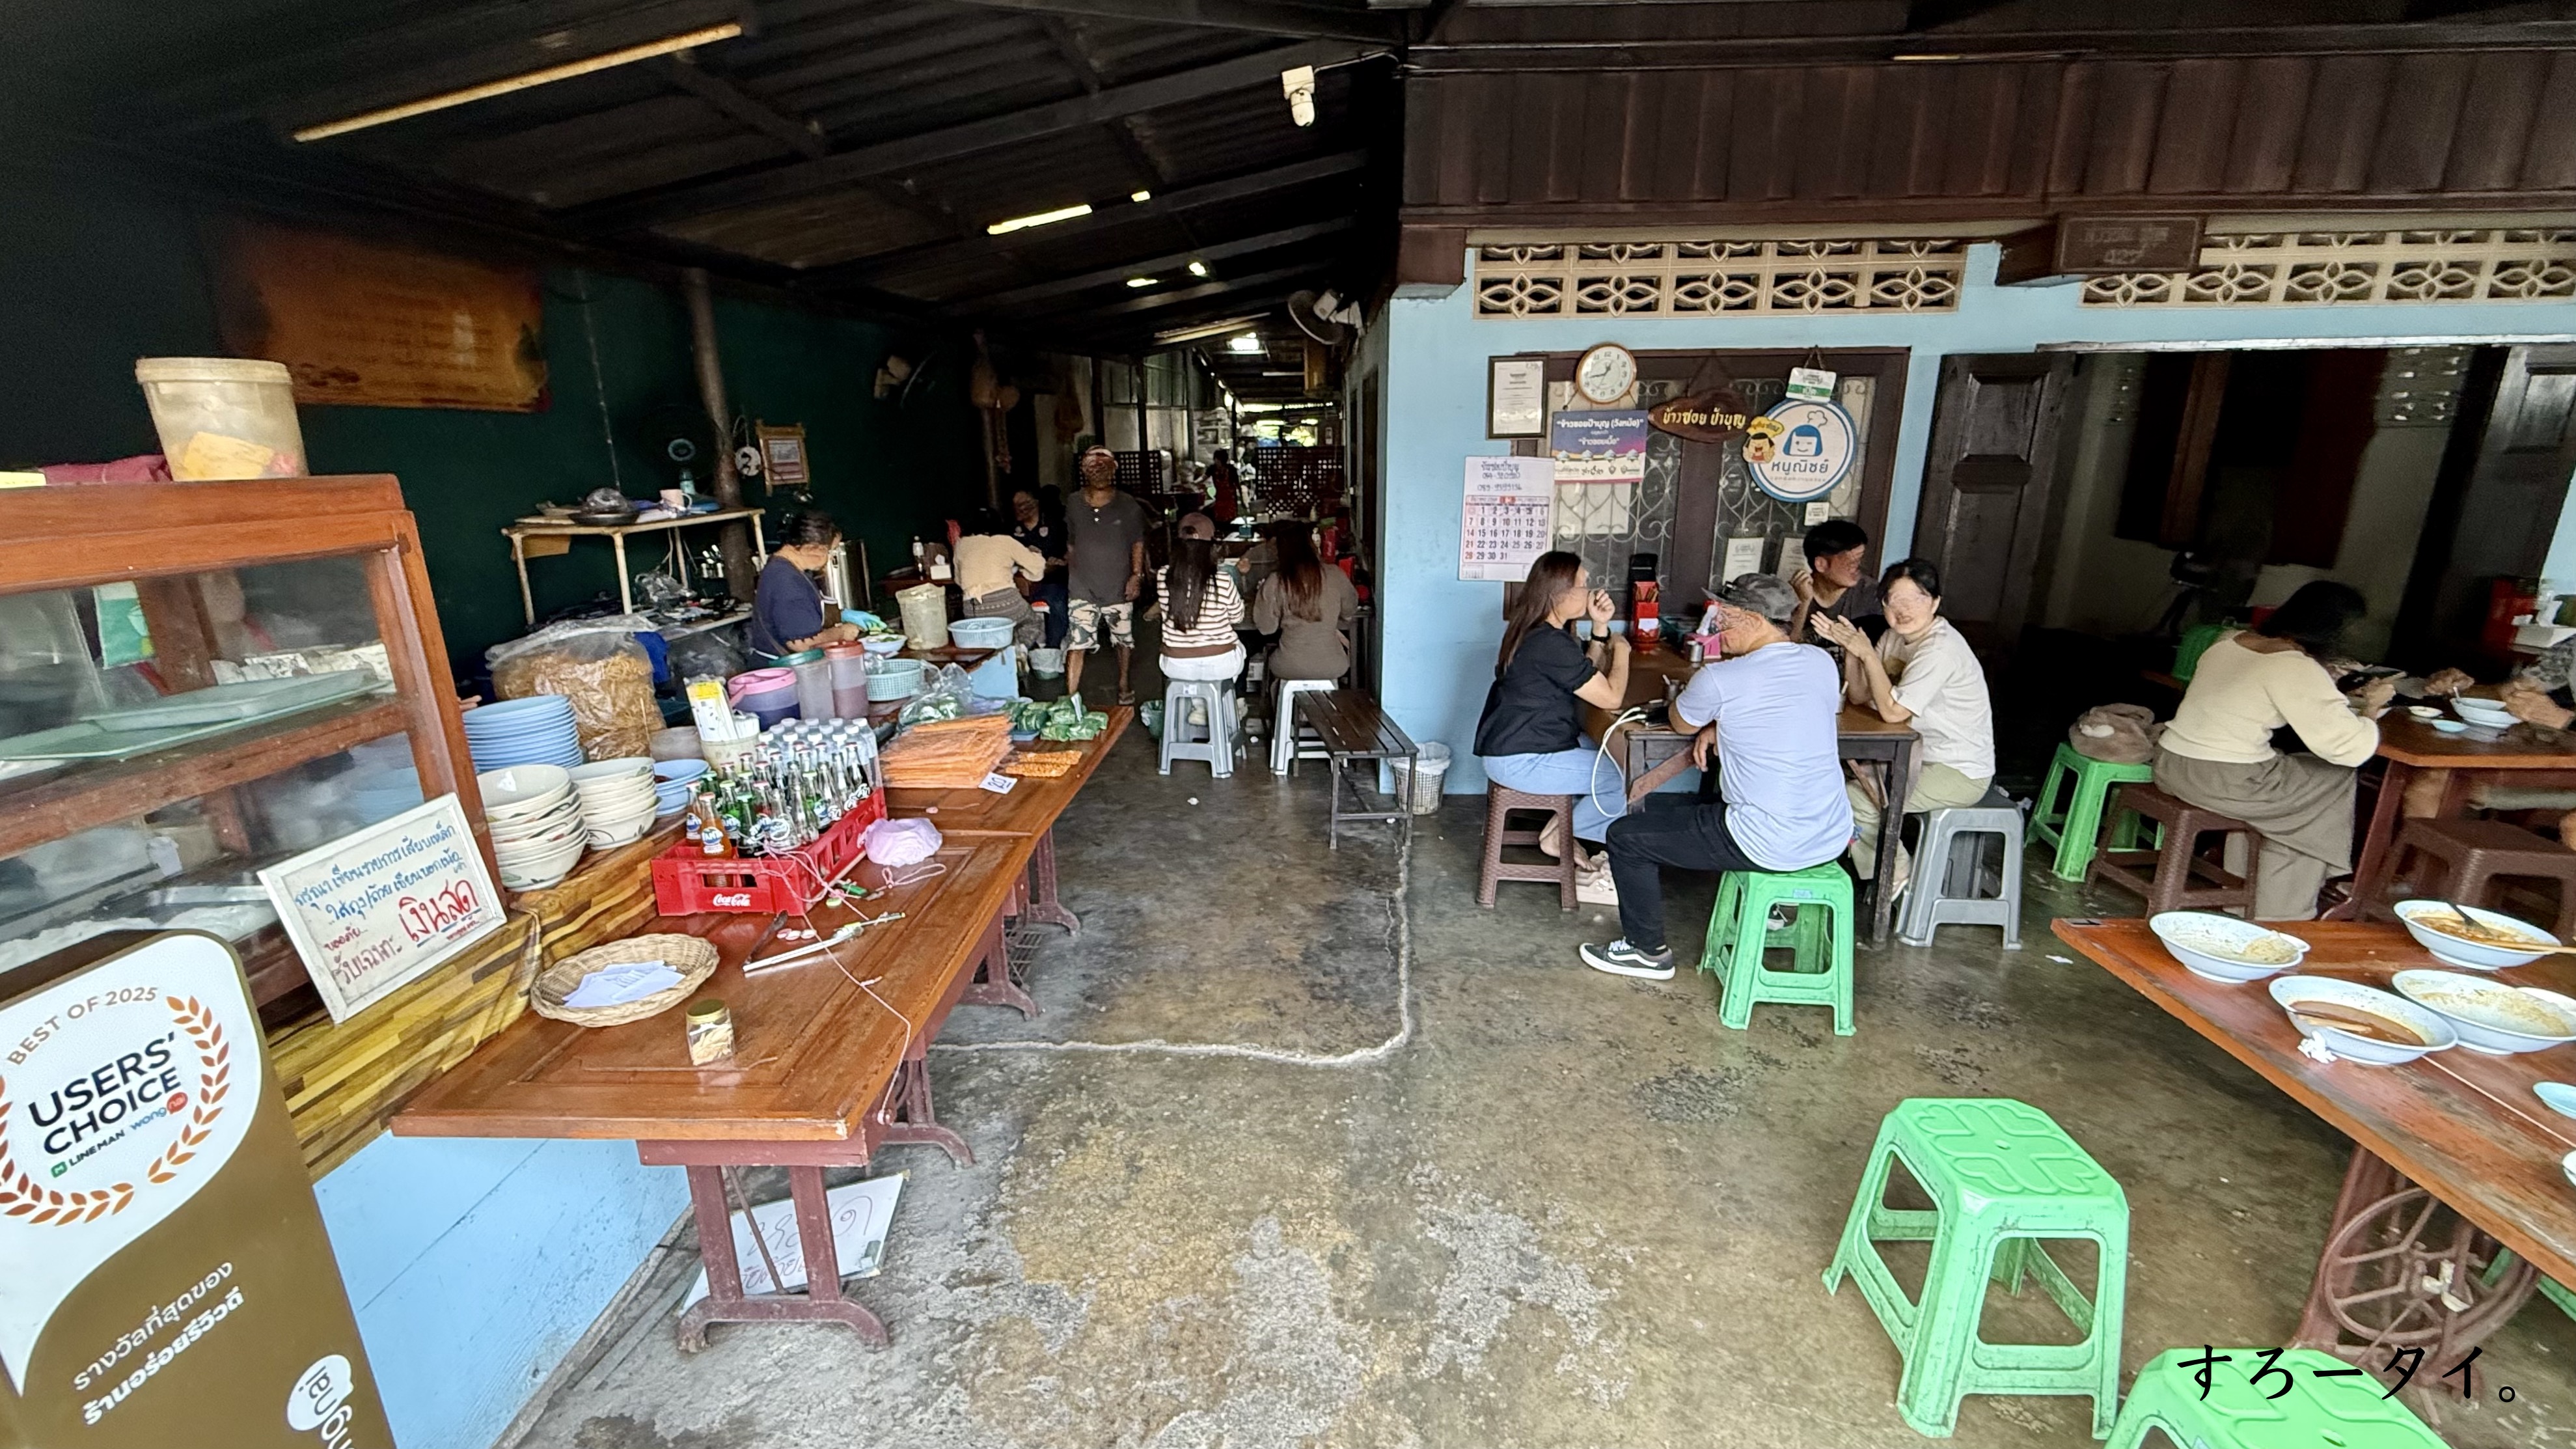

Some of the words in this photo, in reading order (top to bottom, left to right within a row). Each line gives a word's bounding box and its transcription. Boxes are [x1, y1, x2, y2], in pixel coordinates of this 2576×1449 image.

[1771, 459, 1829, 476] หนูณิชย์
[1481, 518, 1485, 526] 8
[1524, 541, 1532, 549] 26
[399, 879, 479, 942] เงินสด
[331, 935, 403, 985] รับเฉพาะ
[7, 1015, 60, 1065] BEST
[67, 996, 99, 1019] OF
[105, 987, 158, 1006] 2025
[28, 1032, 175, 1127] USERS'
[44, 1066, 182, 1155] CHOICE
[74, 1262, 233, 1390] รางวัลที่สุดของ
[83, 1285, 244, 1425] ร้านอร่อยรีวิวดี
